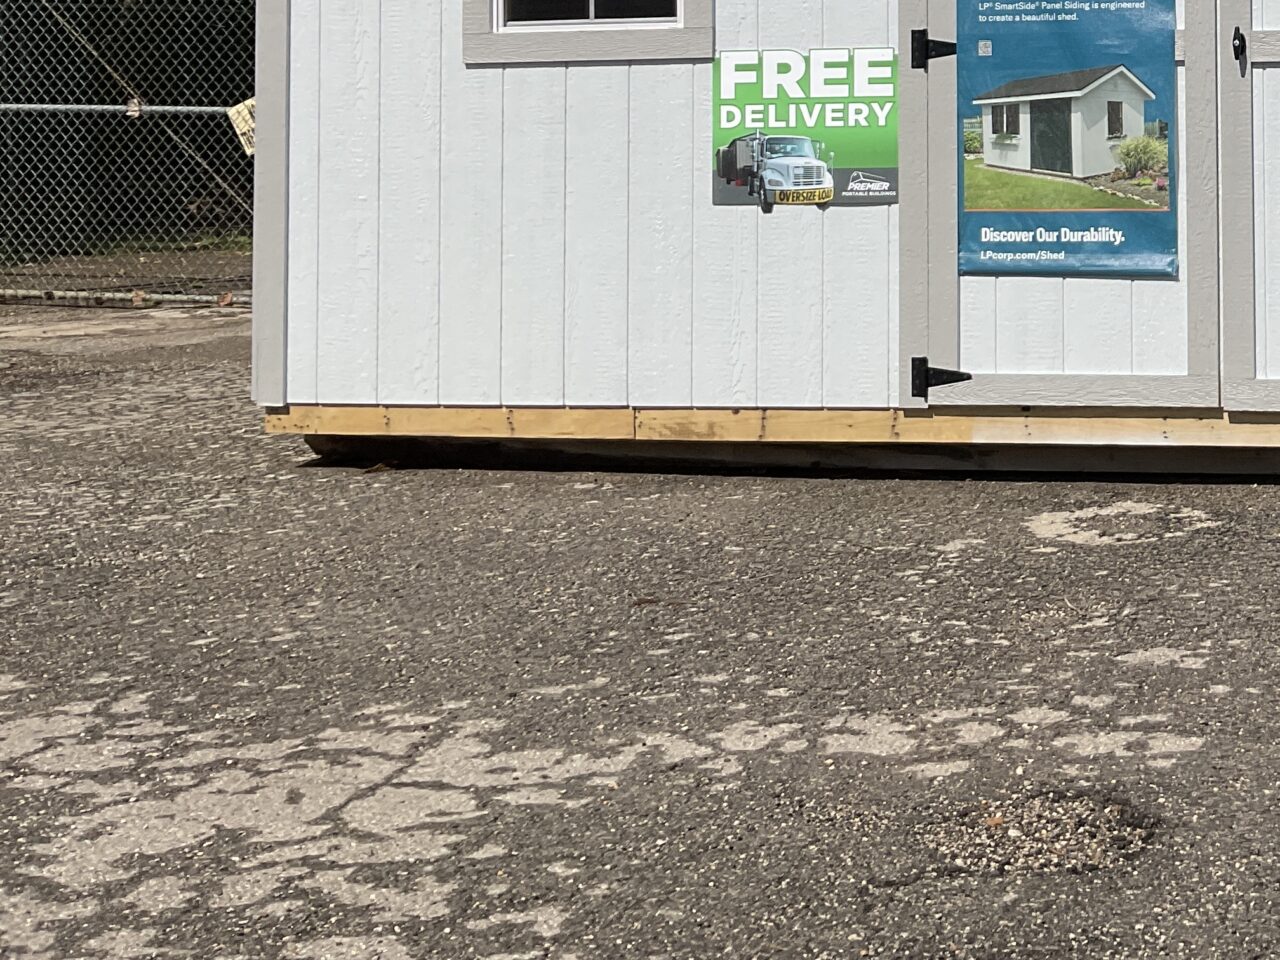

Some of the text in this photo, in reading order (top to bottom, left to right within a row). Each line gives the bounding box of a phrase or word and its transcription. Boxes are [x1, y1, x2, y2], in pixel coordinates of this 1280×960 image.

[1041, 1, 1063, 10] Panel
[1064, 1, 1090, 11] Siding
[1091, 1, 1099, 9] is
[1100, 0, 1146, 11] engineered
[988, 14, 1013, 22] create
[1021, 13, 1056, 21] beautiful
[1057, 12, 1079, 21] shed.
[719, 48, 895, 100] FREE
[719, 102, 894, 128] DELIVERY
[847, 182, 890, 191] PREMIER
[778, 190, 816, 202] OVERSIZE
[981, 227, 1125, 245] Discover Our Durability.
[980, 251, 1065, 261] LPcorp.com/Shed
